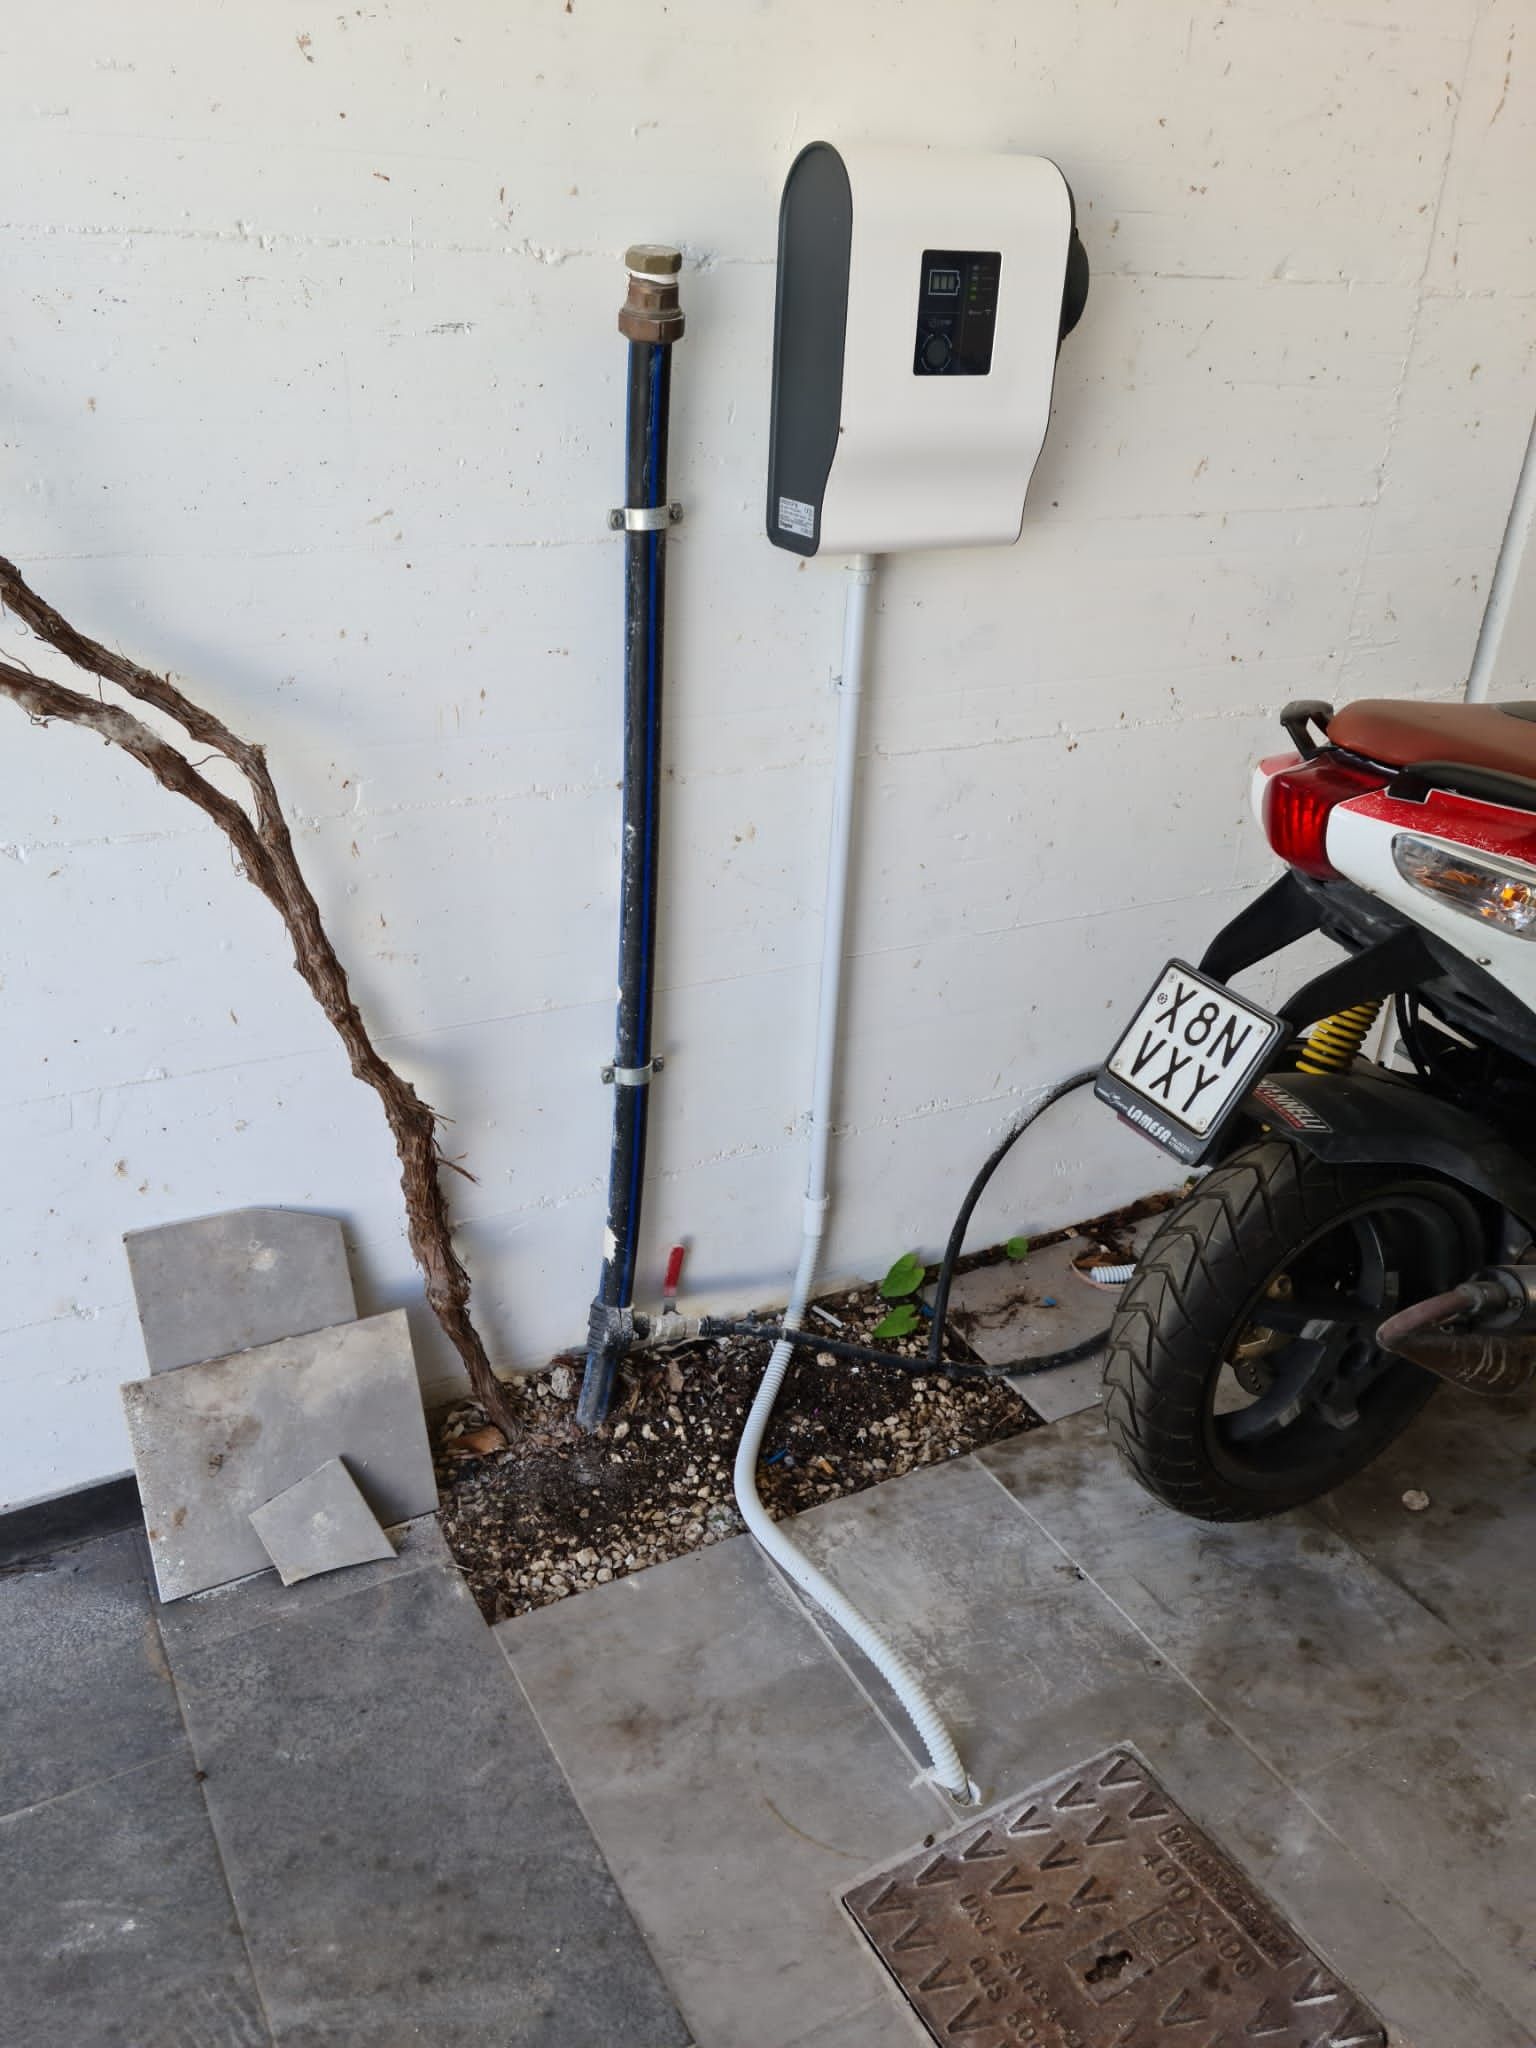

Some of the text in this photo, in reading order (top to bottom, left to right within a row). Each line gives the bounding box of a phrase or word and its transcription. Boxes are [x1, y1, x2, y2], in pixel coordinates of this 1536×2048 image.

[1155, 982, 1253, 1068] X8N
[1130, 1030, 1219, 1113] VXY
[1126, 1105, 1173, 1144] LAMESA
